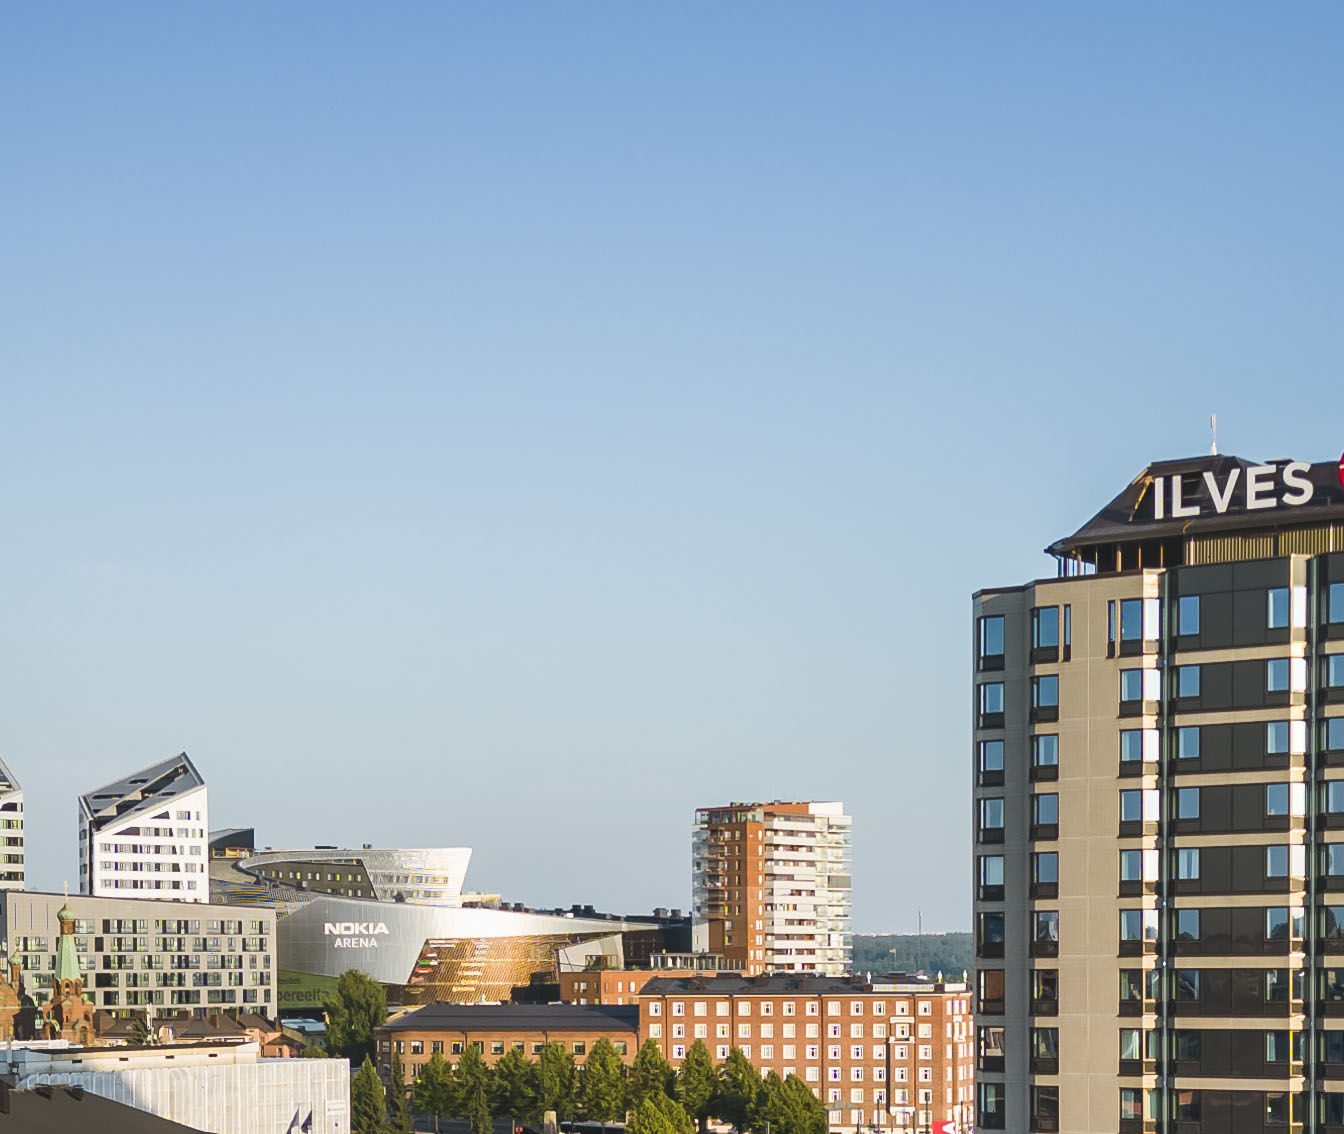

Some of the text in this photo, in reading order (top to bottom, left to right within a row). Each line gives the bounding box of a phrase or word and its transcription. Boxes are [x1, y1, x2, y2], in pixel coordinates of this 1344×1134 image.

[1154, 461, 1314, 520] ILVES
[324, 922, 389, 935] NOKIA
[334, 938, 378, 948] ARENA
